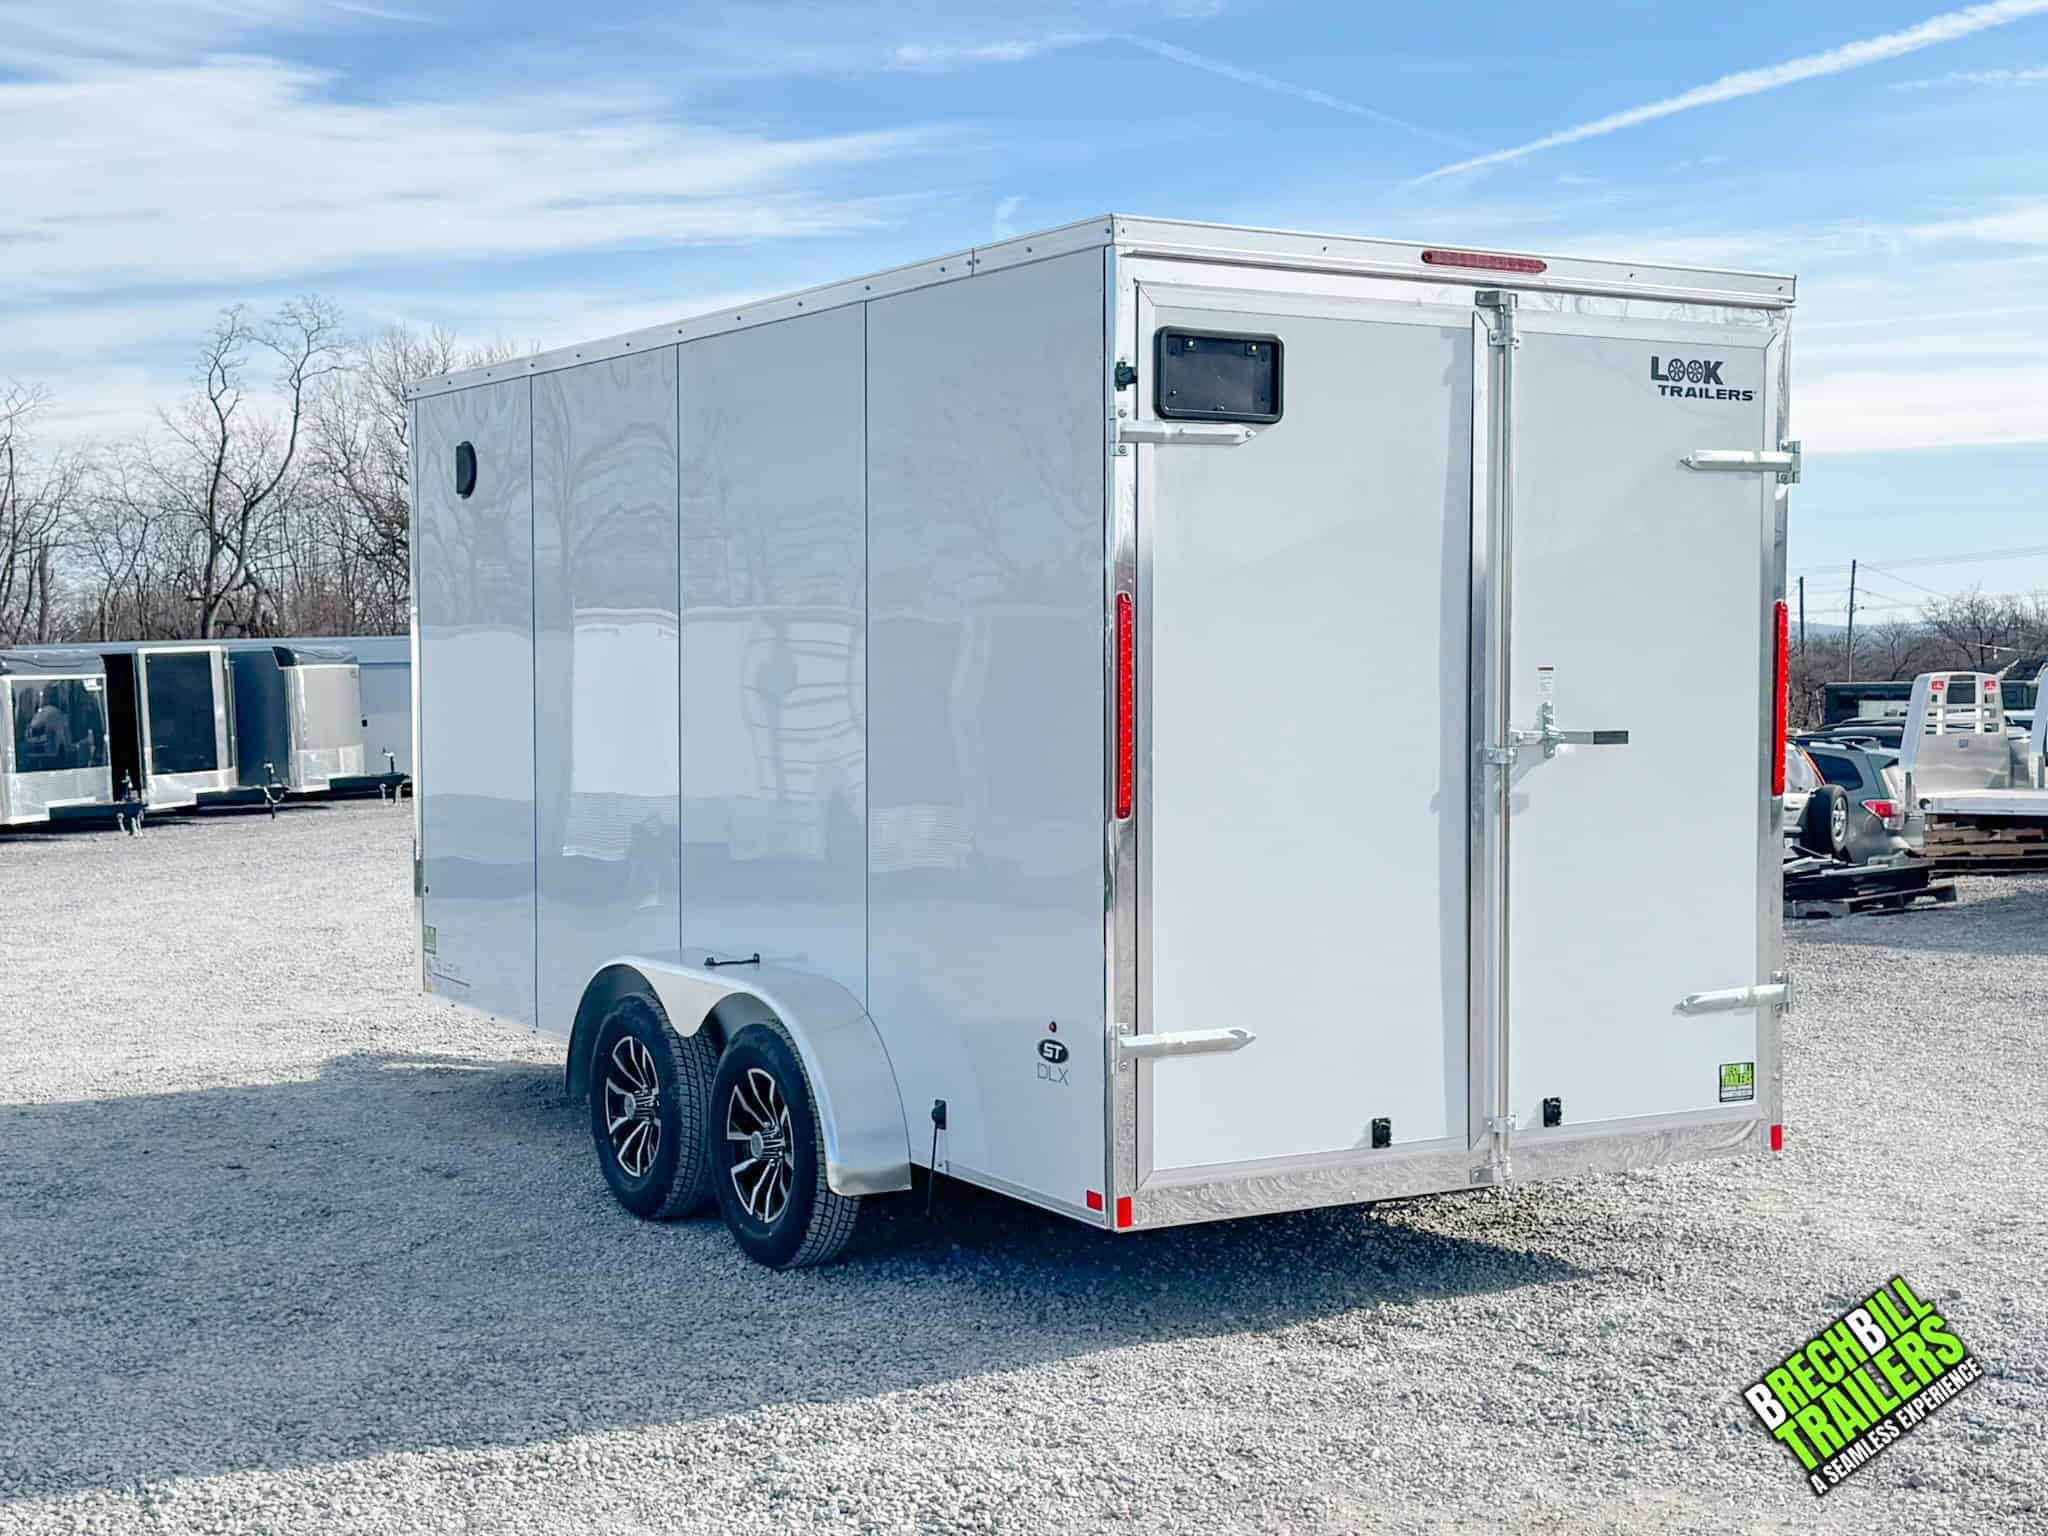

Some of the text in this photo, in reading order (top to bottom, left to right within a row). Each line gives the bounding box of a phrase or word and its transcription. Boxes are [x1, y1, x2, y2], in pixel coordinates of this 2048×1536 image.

[1651, 356, 1724, 385] LOOK
[1658, 384, 1753, 401] TRAILERS
[1043, 1042, 1063, 1059] ST
[1038, 1063, 1069, 1086] DLX
